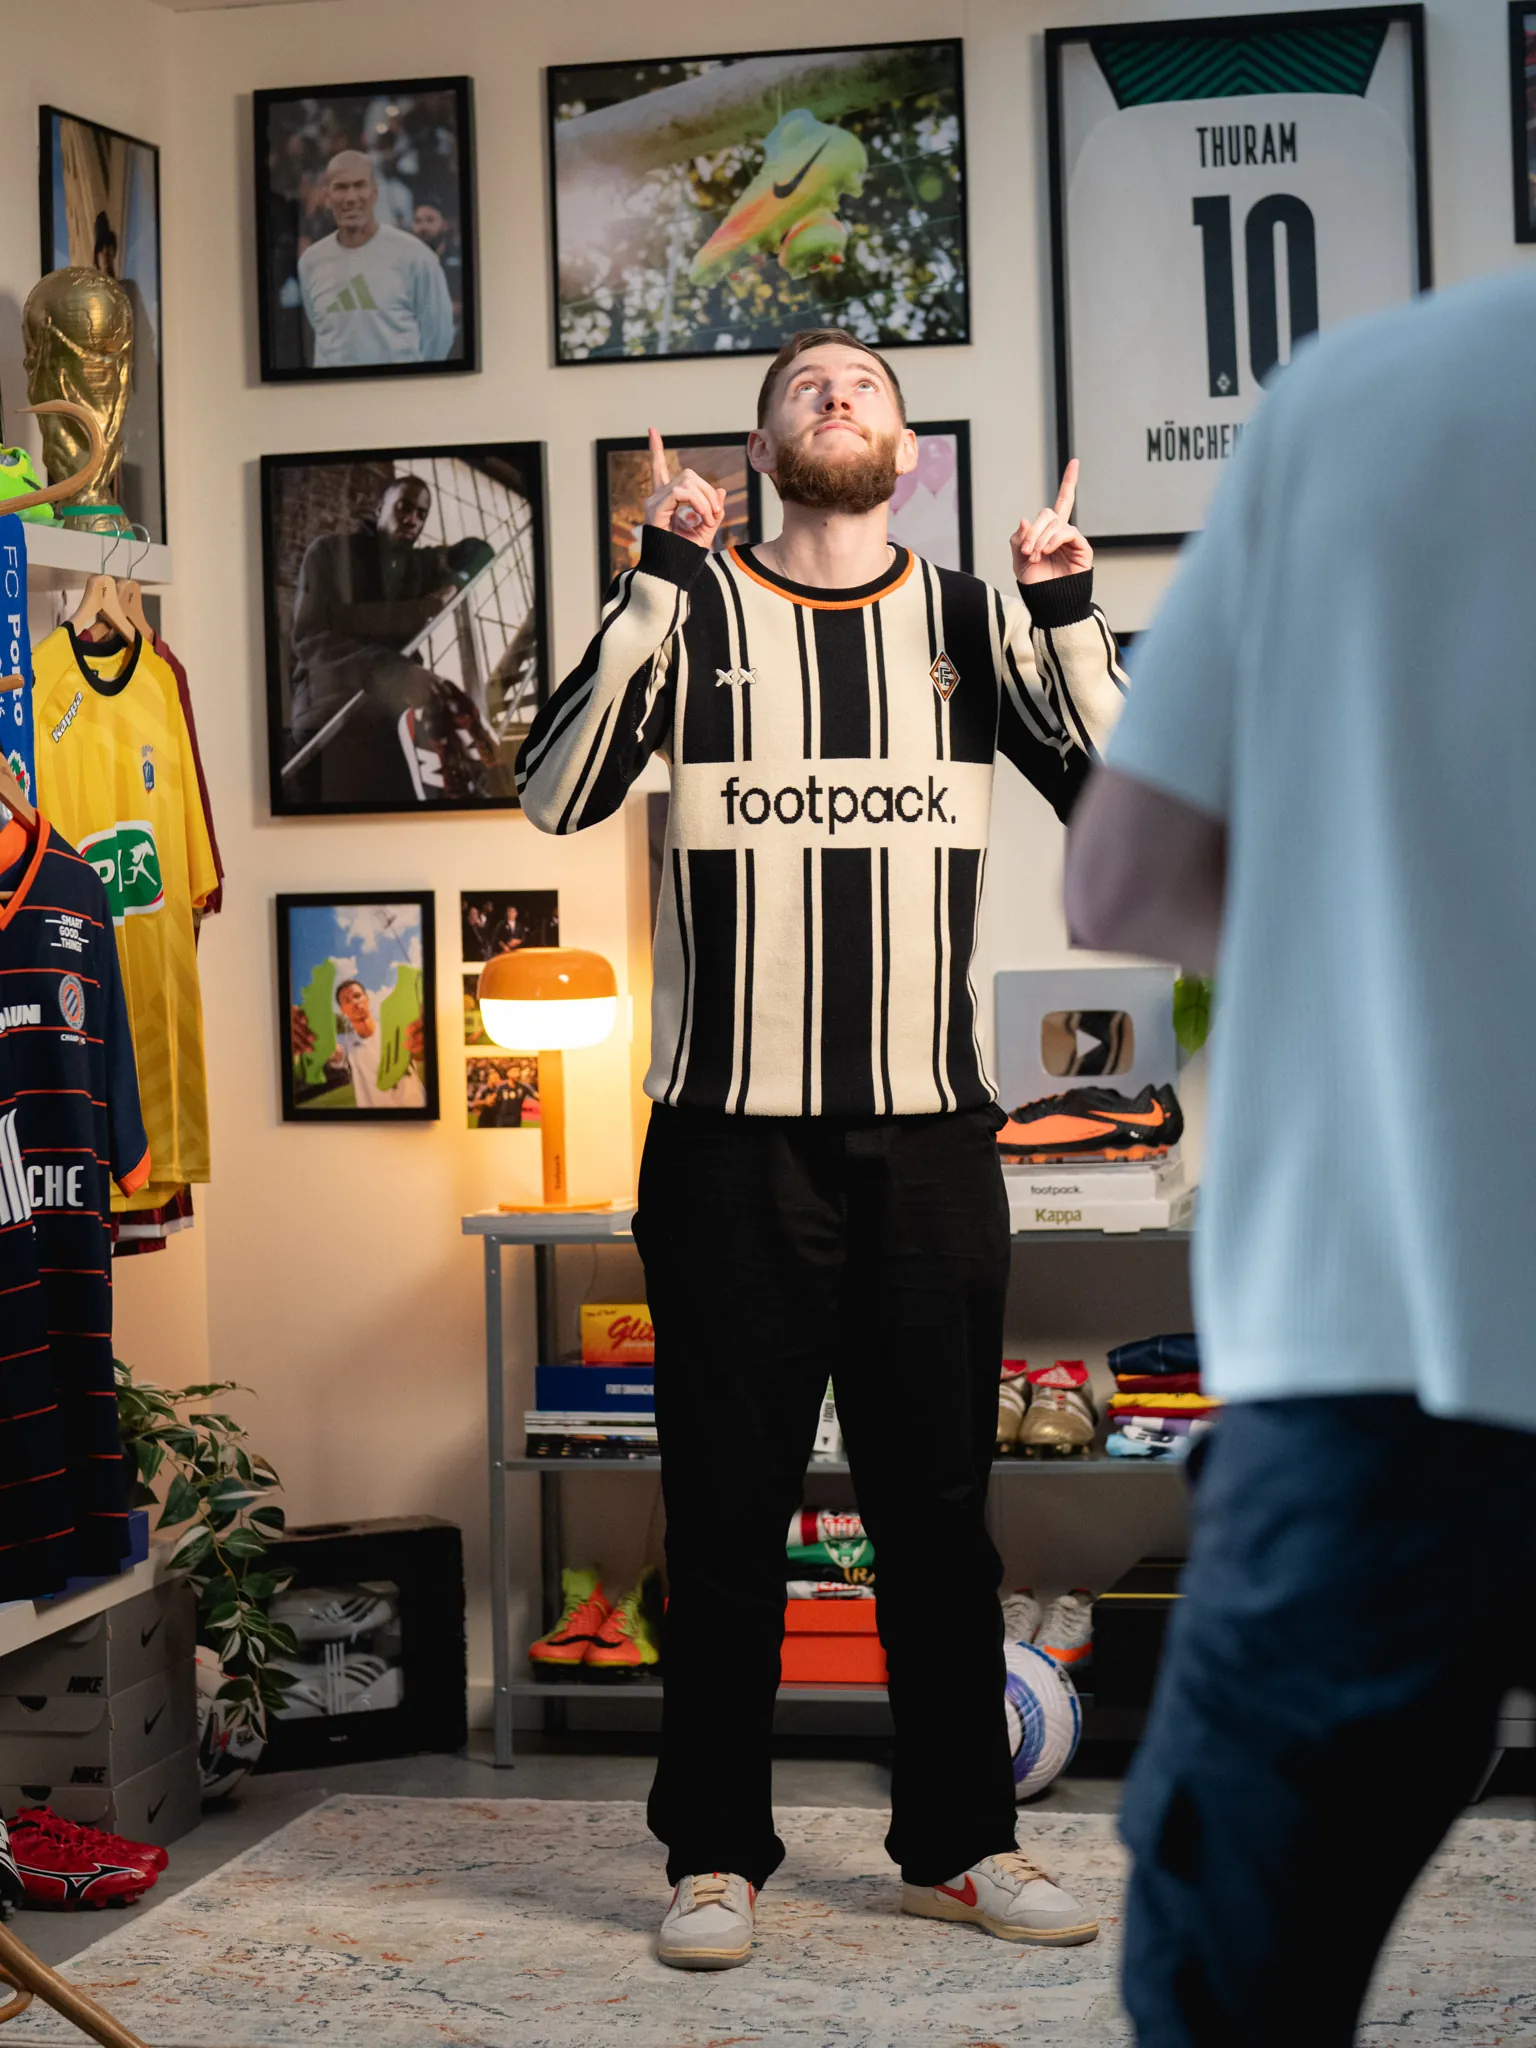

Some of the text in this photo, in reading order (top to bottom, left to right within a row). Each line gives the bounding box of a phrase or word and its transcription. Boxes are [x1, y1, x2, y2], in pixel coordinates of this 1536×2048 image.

[1196, 122, 1298, 168] THURAM
[1192, 193, 1320, 398] 10
[3, 545, 19, 598] FC
[51, 690, 84, 744] Kappa
[720, 775, 957, 835] footpack.
[61, 914, 84, 930] SMART
[59, 925, 79, 940] GOOD
[60, 937, 82, 953] THINGS
[1035, 1208, 1082, 1225] Kappa
[66, 1675, 104, 1694] NIKE
[70, 1765, 107, 1784] NIKE
